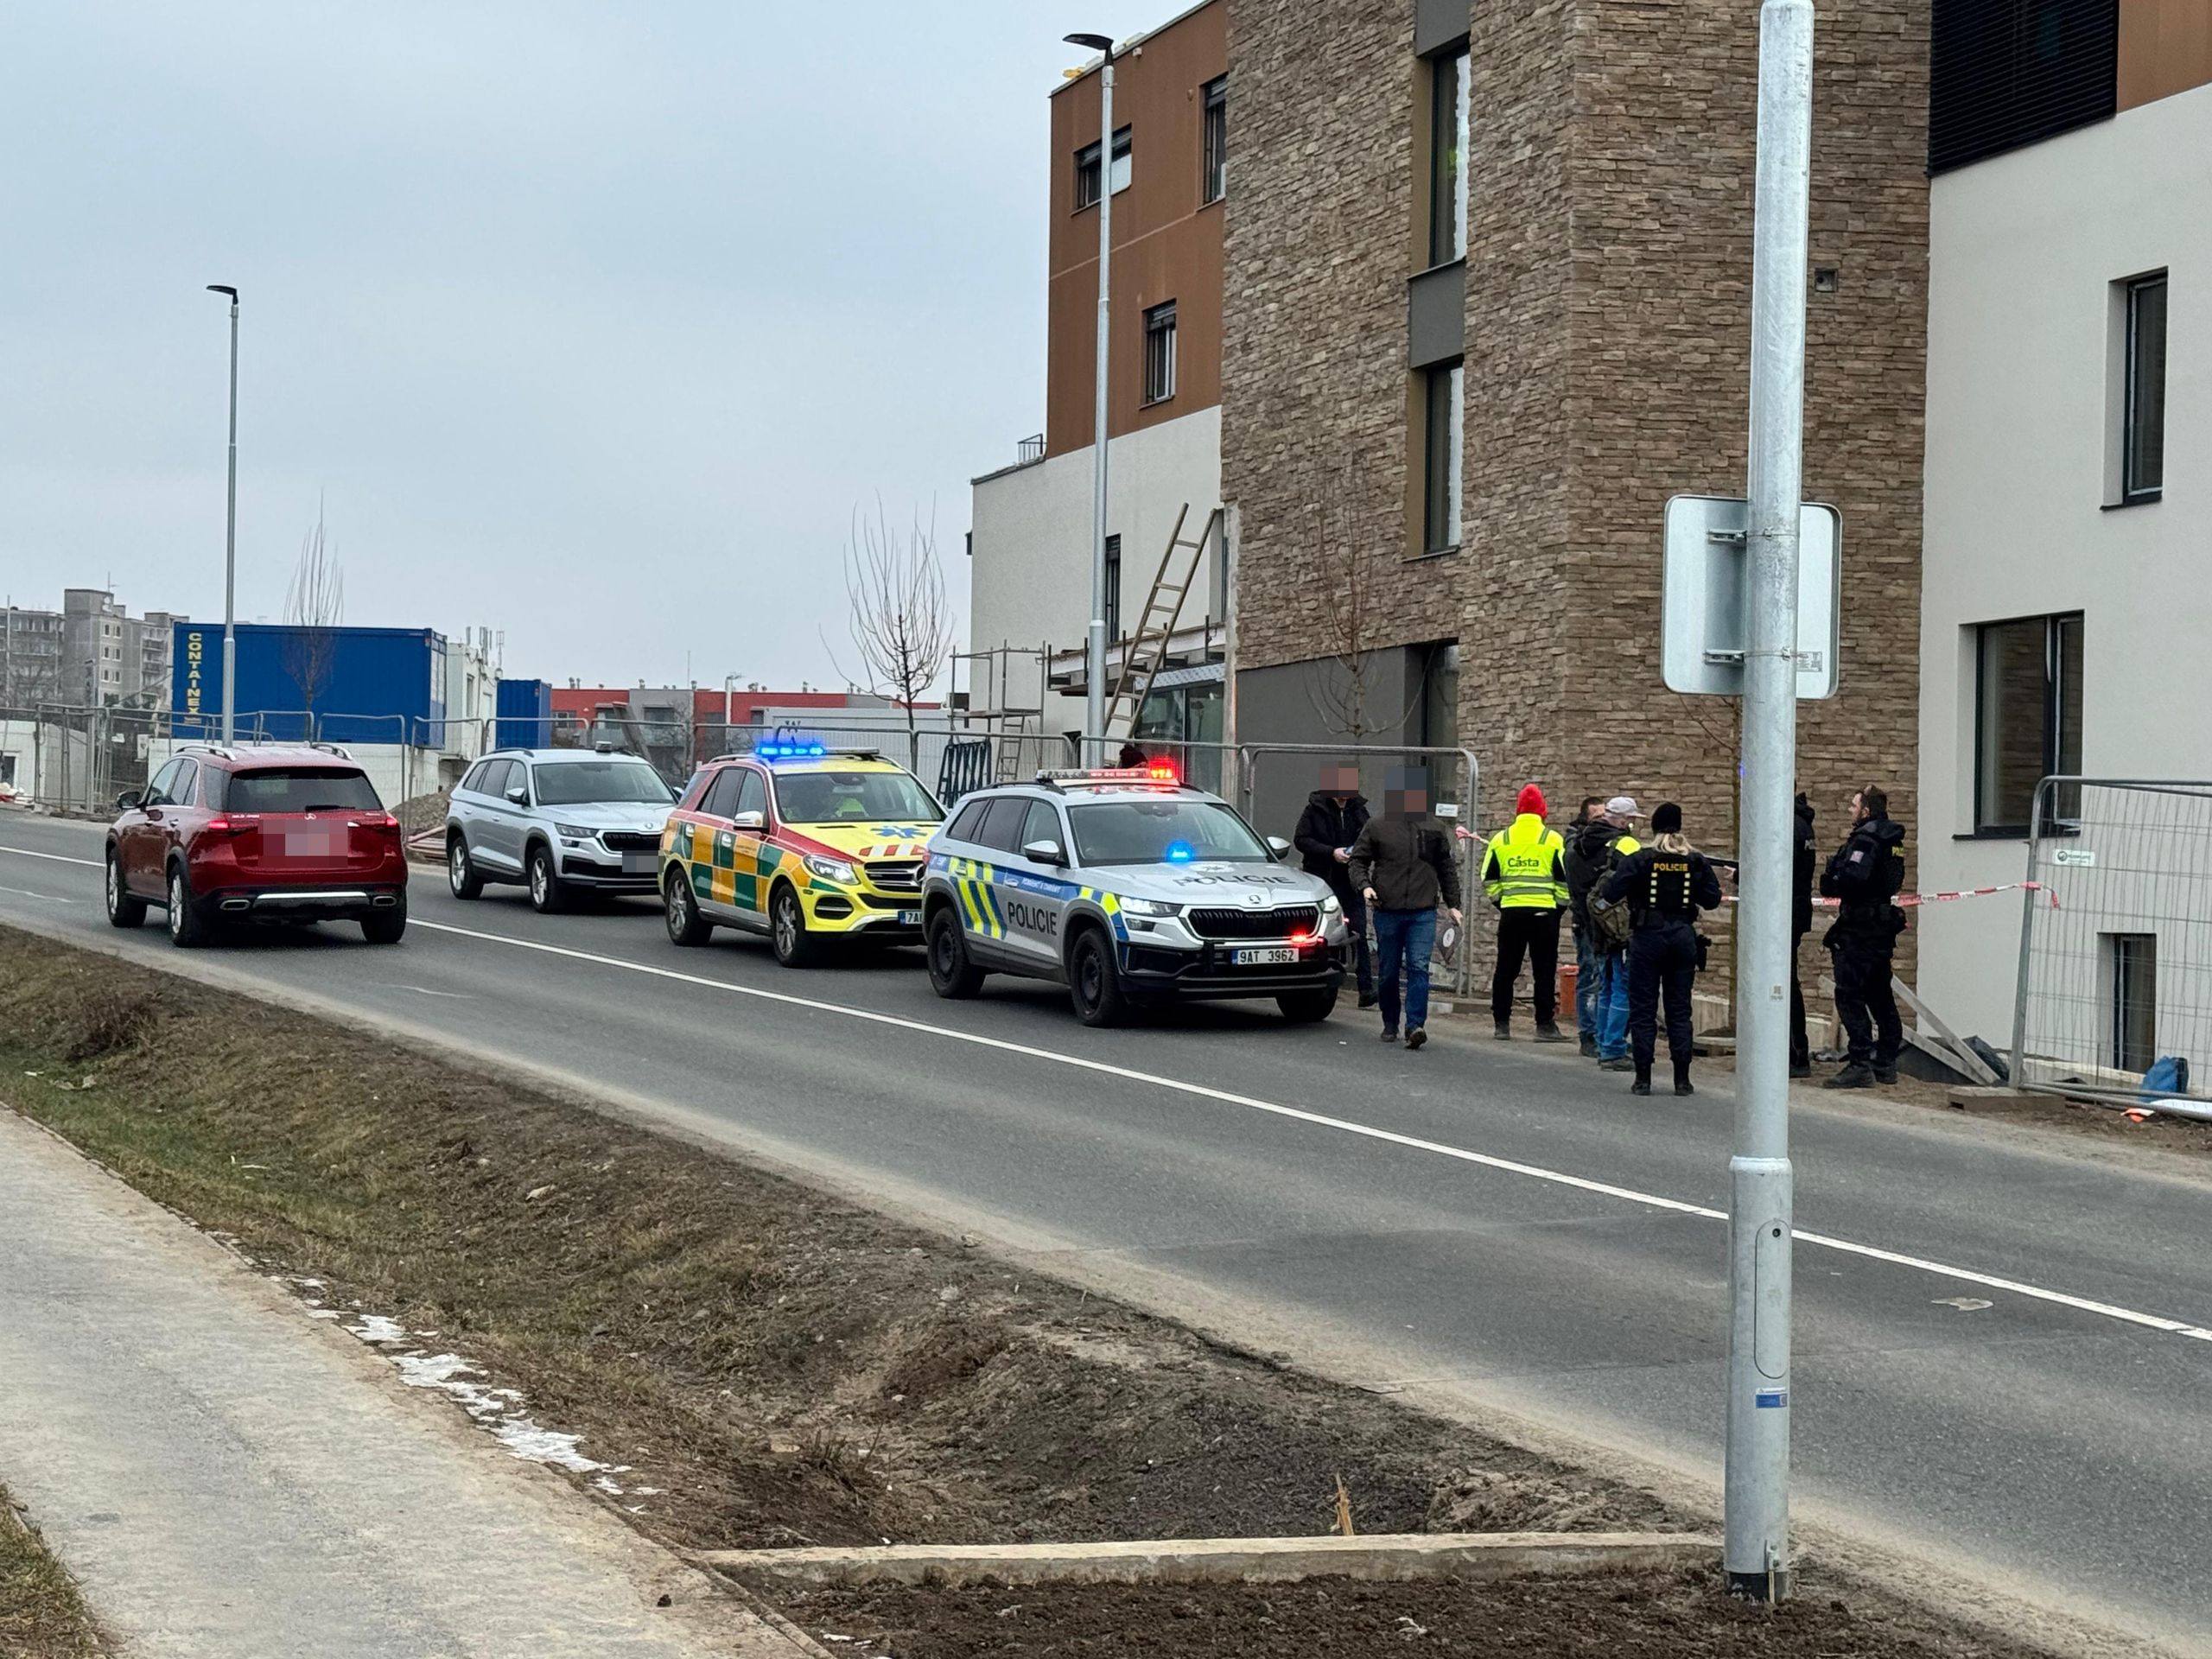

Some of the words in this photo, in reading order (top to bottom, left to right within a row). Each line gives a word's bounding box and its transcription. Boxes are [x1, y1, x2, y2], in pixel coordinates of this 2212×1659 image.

[188, 632, 202, 715] CONTAINEX
[1653, 862, 1688, 872] POLICIE
[1173, 874, 1296, 887] POLICIE
[906, 912, 922, 923] 7A
[1007, 900, 1058, 937] POLICIE
[1239, 951, 1261, 963] 9AT
[1268, 950, 1294, 963] 3962
